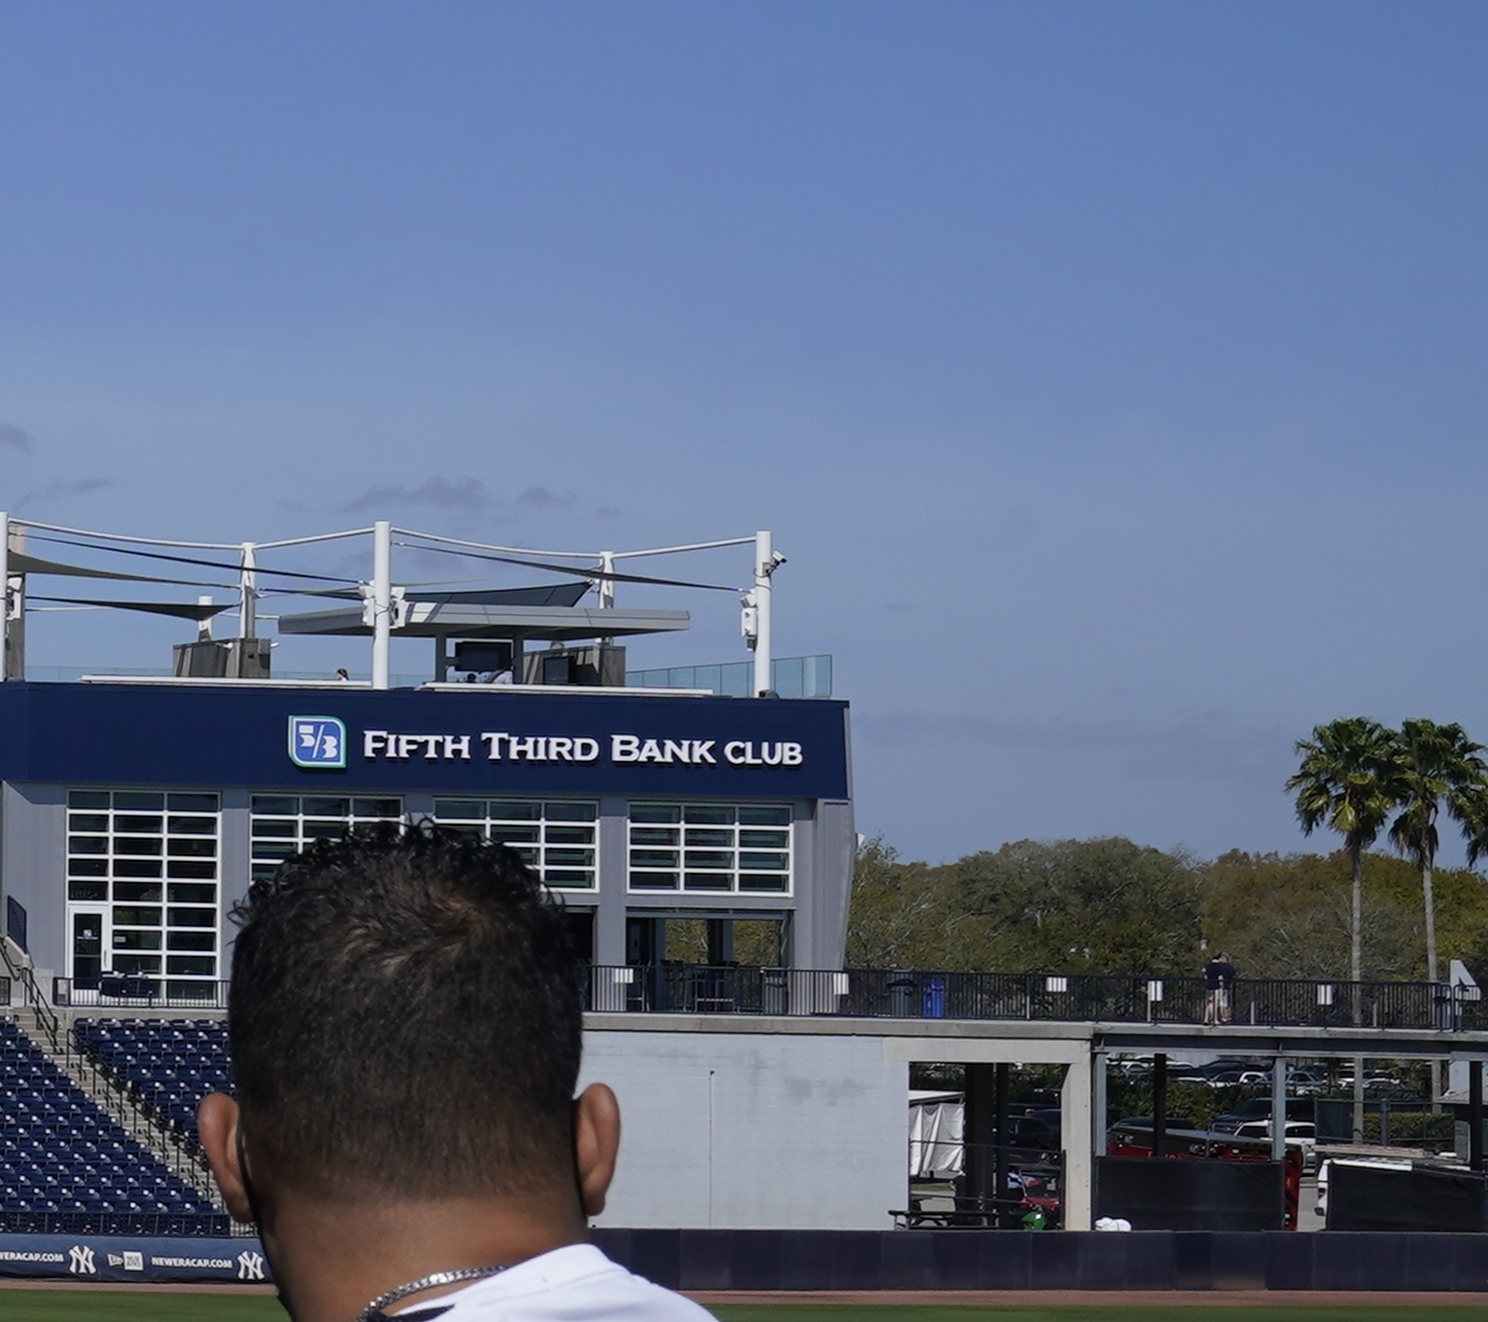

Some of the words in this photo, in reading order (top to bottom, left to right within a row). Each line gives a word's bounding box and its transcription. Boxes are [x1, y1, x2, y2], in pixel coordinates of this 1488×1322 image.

[363, 730, 472, 760] FIFTH
[481, 731, 600, 764] THIRD
[612, 734, 717, 766] BANK
[724, 739, 804, 767] CLUB
[152, 1256, 233, 1269] NEWERACAP.COM
